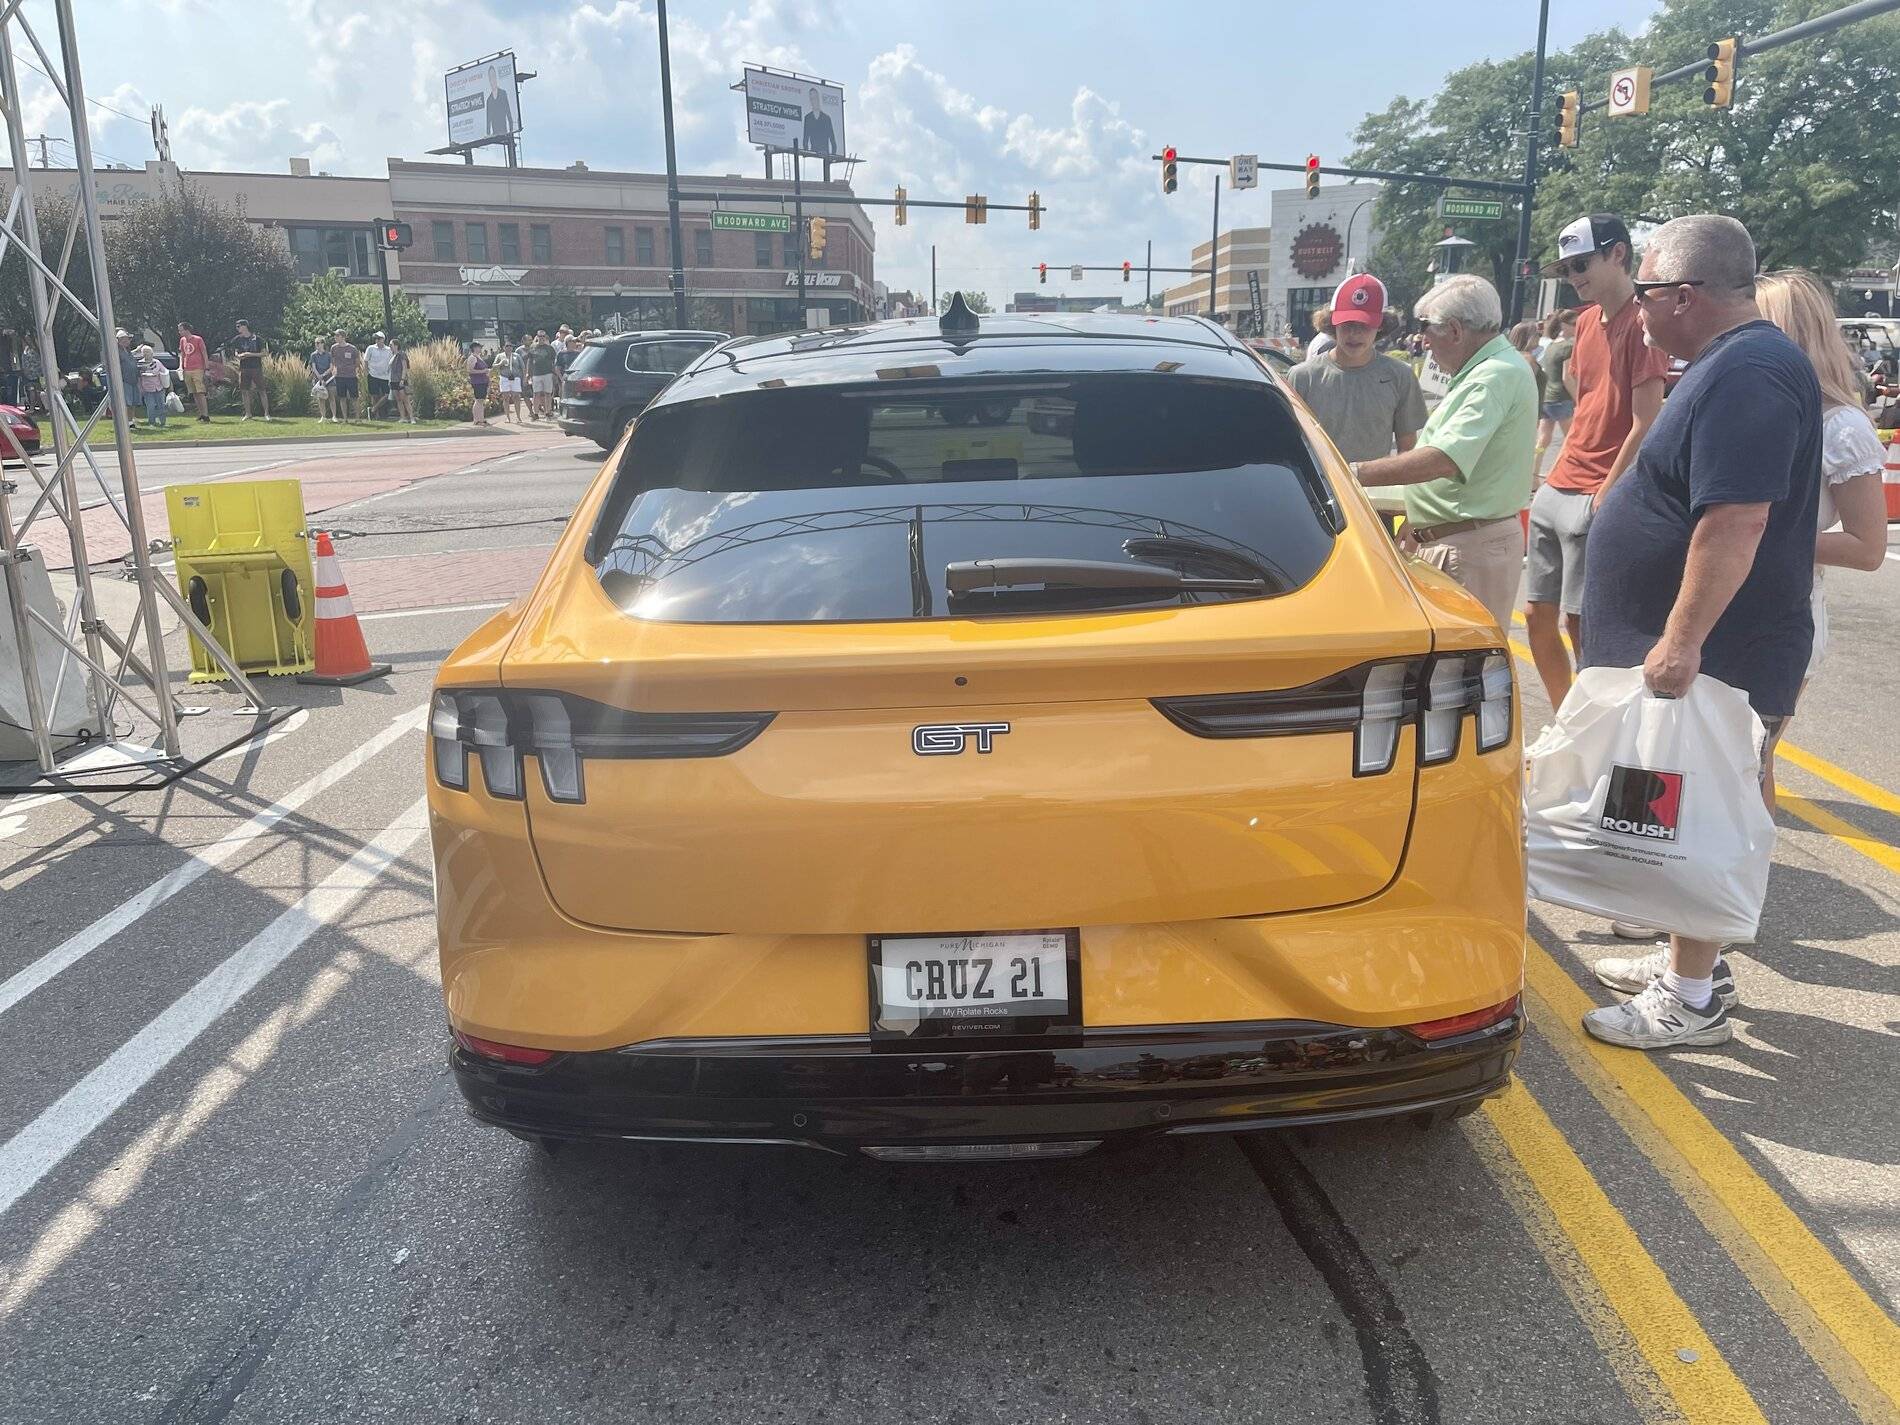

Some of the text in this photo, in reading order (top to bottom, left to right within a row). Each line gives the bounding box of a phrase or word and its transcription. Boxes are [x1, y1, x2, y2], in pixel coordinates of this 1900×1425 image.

[752, 101, 782, 114] STRATEGY
[1445, 203, 1484, 215] WOODWARD
[717, 216, 787, 229] WOODWARD AVE
[1431, 373, 1440, 381] IN
[912, 722, 1010, 756] GT
[1601, 816, 1676, 840] ROUSH
[905, 956, 1044, 1000] CRUZ 21
[942, 1007, 1008, 1017] My Rplate Rocks
